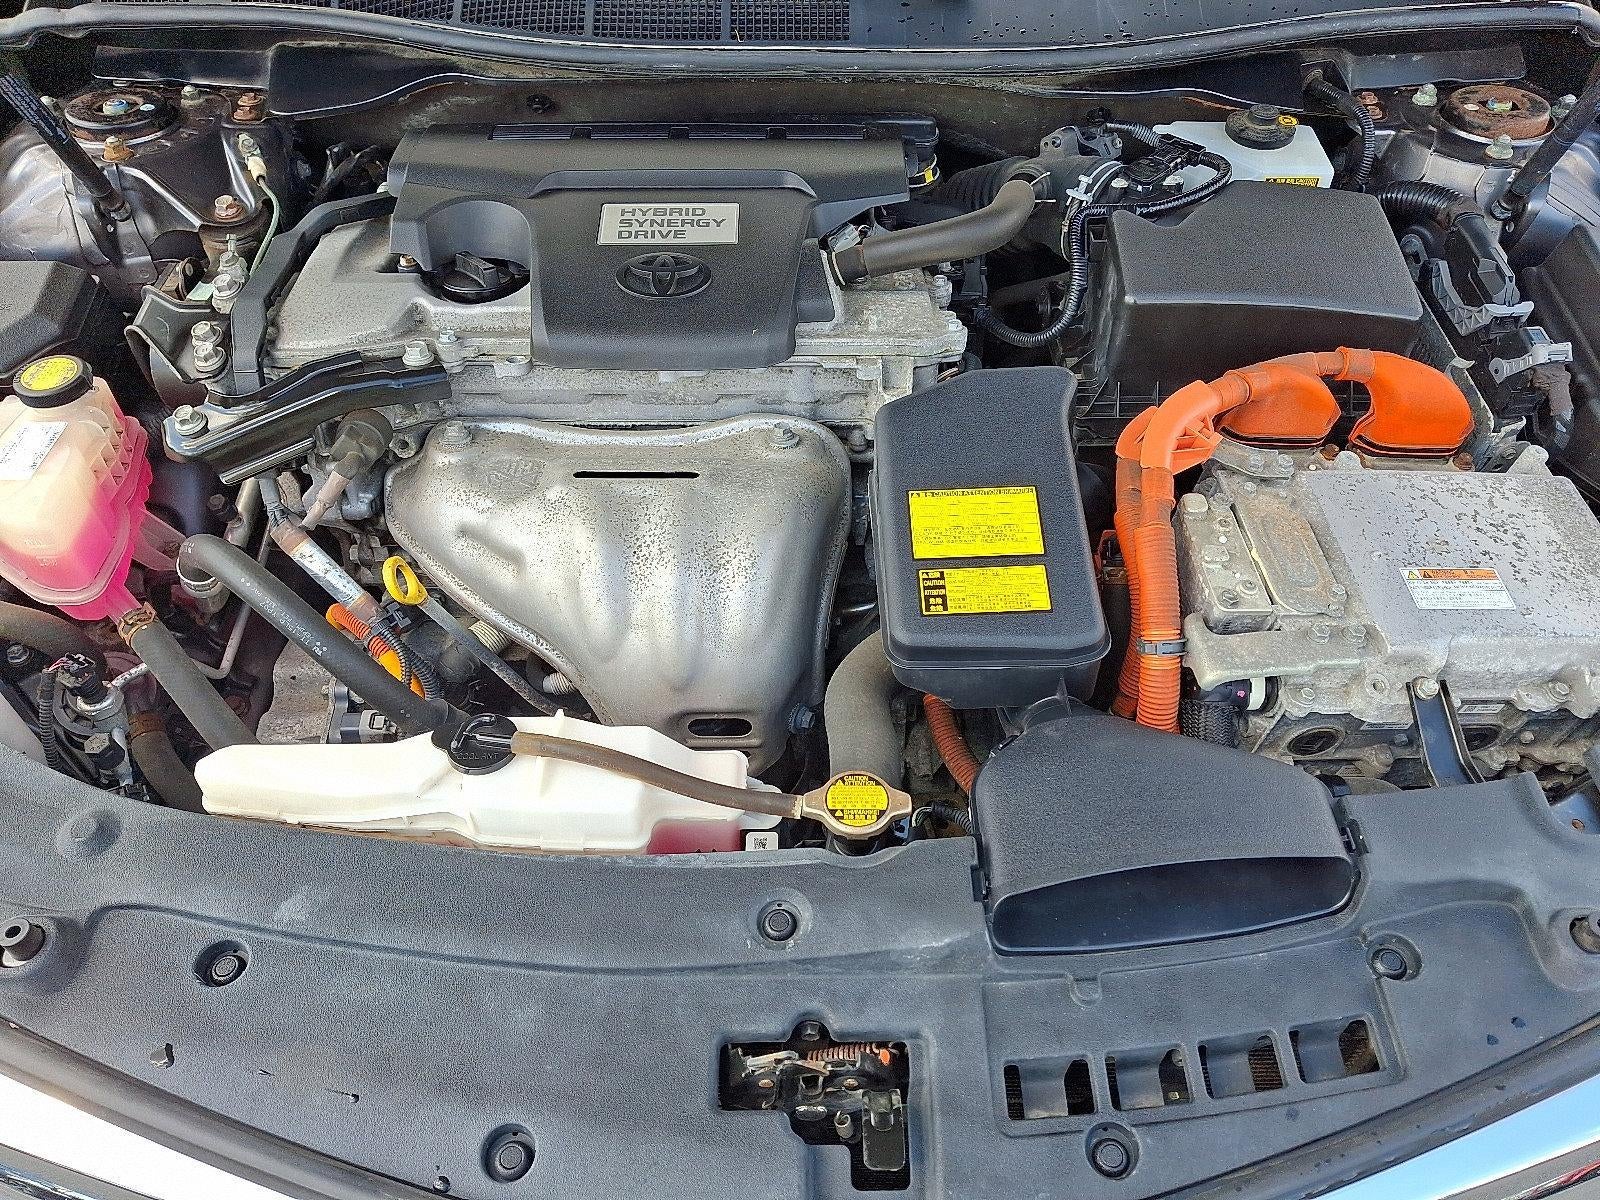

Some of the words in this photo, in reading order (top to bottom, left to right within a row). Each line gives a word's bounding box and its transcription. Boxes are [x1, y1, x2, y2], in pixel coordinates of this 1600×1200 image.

[620, 207, 706, 217] HYBRID
[618, 218, 727, 228] SYNERGY
[617, 229, 687, 239] DRIVE
[923, 579, 945, 587] CAUTION
[924, 588, 946, 596] ATTENTION
[456, 752, 499, 760] COOLANT
